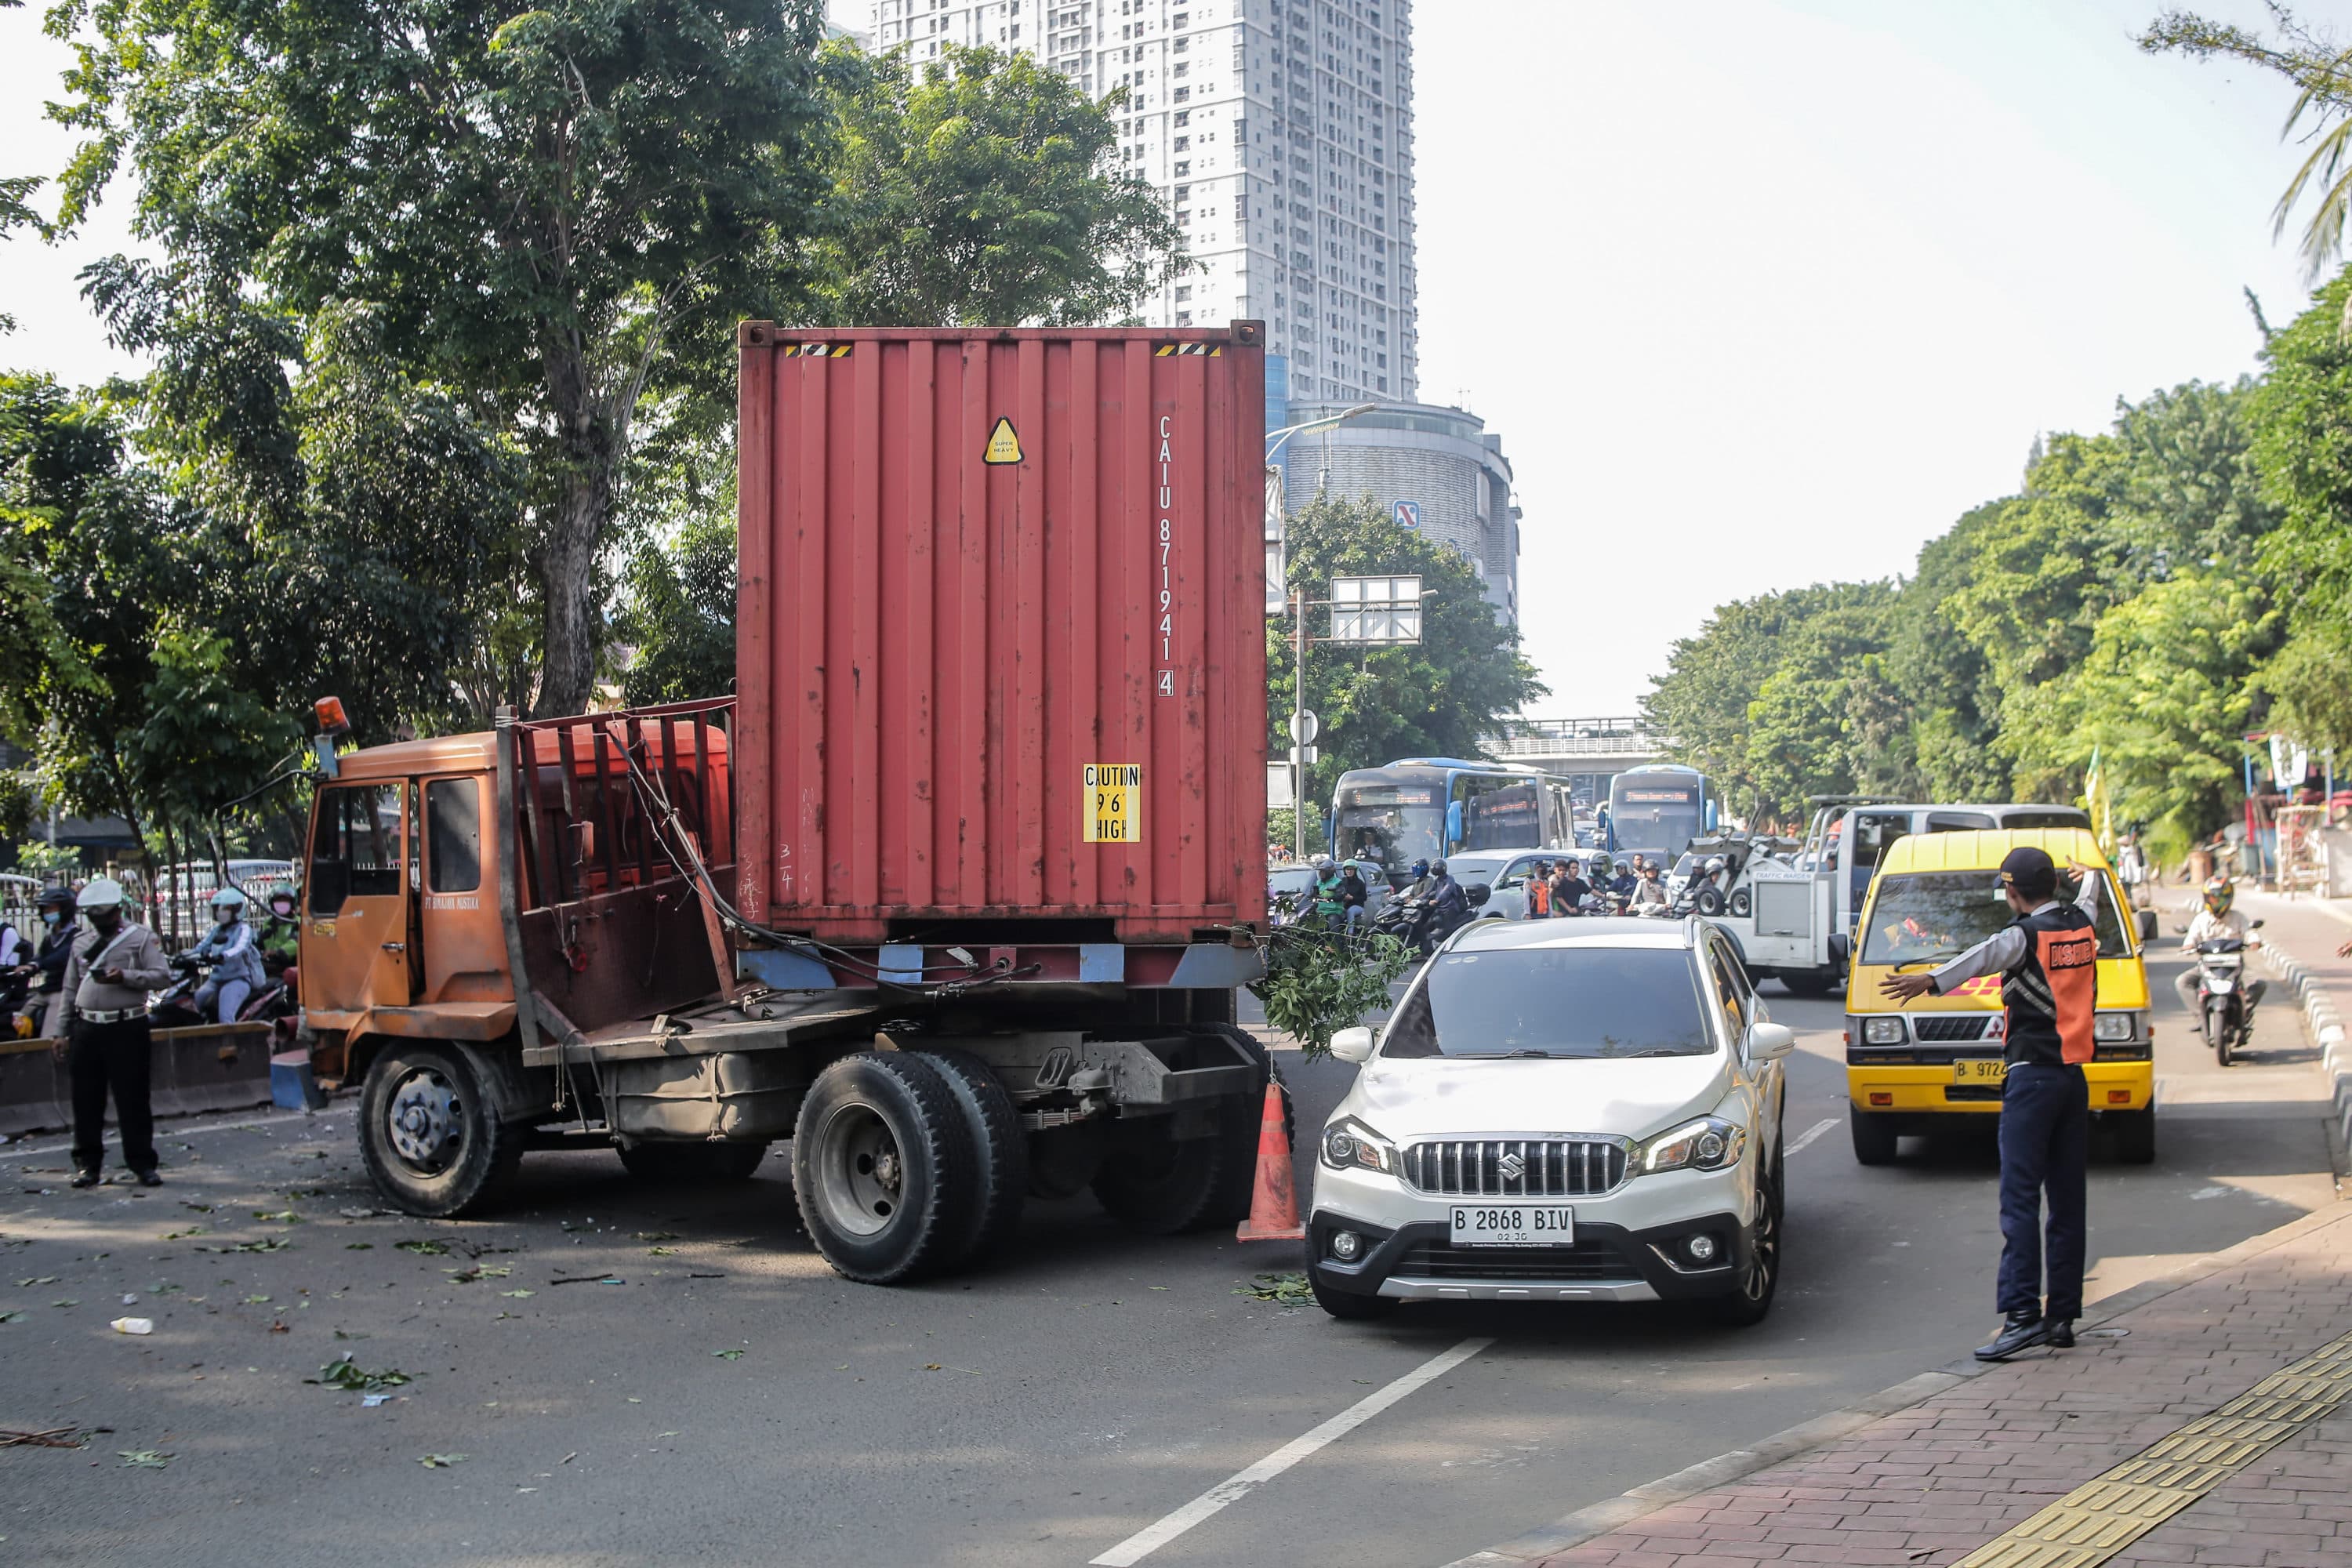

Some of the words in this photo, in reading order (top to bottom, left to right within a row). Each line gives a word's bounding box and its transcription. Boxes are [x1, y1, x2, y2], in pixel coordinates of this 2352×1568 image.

[1159, 416, 1171, 510] CAIU
[1159, 518, 1171, 660] 871941
[1160, 671, 1172, 695] 4
[1085, 767, 1138, 786] CAUTION
[1097, 819, 1127, 839] HIGH
[425, 896, 431, 910] PT
[1958, 1062, 1965, 1076] B
[1455, 1210, 1466, 1230] B
[1476, 1210, 1522, 1230] 2868
[1534, 1210, 1569, 1230] BIV
